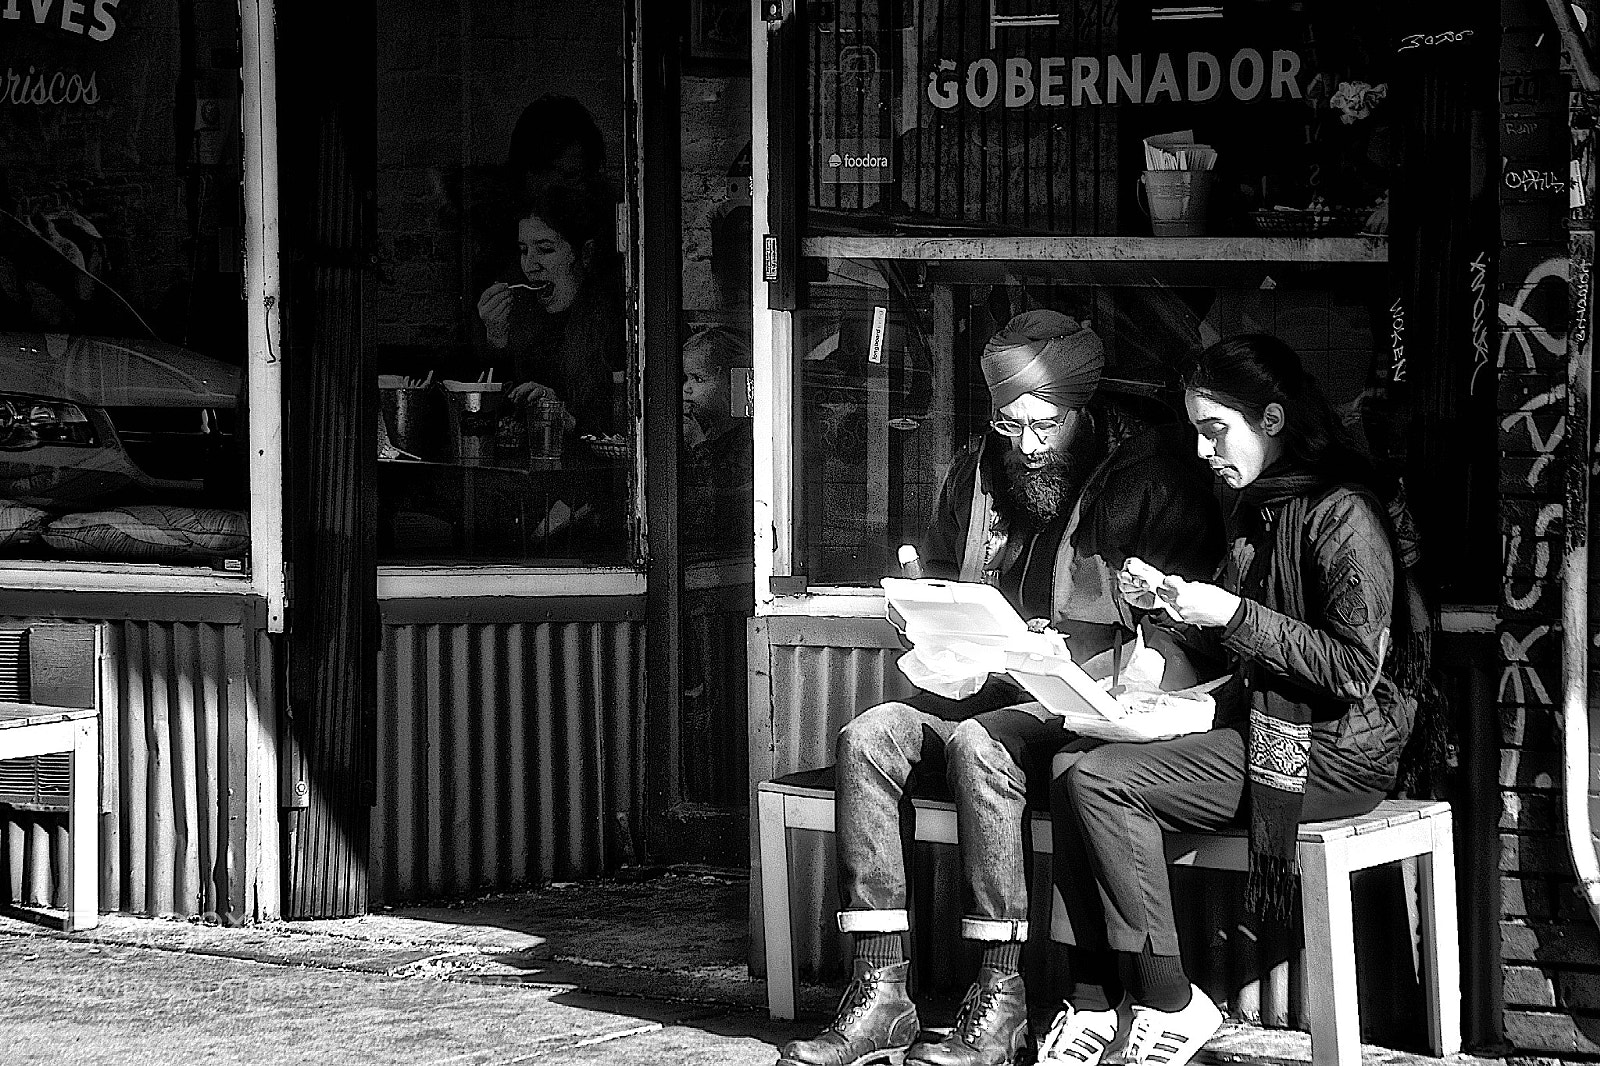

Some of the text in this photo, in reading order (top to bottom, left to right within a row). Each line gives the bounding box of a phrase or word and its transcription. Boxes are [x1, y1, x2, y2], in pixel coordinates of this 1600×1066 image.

[0, 65, 100, 105] riscos
[927, 48, 1303, 109] GOBERNADOR
[843, 153, 888, 168] foodora
